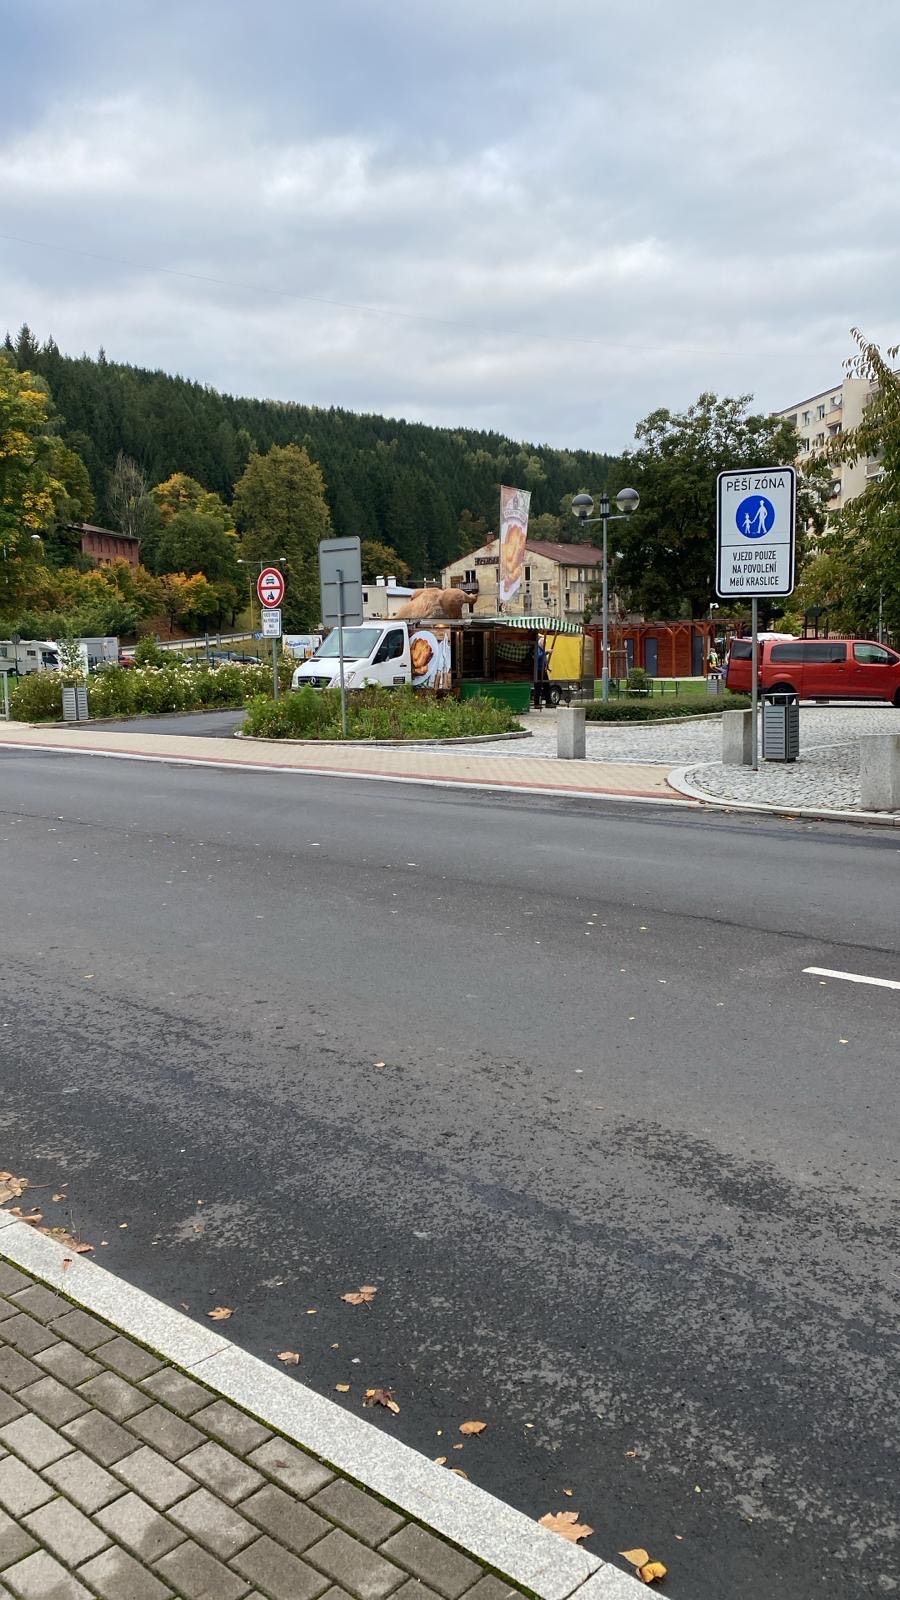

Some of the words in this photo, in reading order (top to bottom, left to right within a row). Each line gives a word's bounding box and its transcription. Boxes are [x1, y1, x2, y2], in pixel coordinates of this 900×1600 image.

[727, 477, 751, 492] PĚŠÍ
[754, 476, 785, 490] ZÓNA
[733, 551, 752, 561] VJEZD
[755, 550, 776, 560] POUZE
[732, 564, 741, 574] NA
[743, 561, 776, 573] POVOLENÍ
[746, 576, 779, 586] KRASLICE
